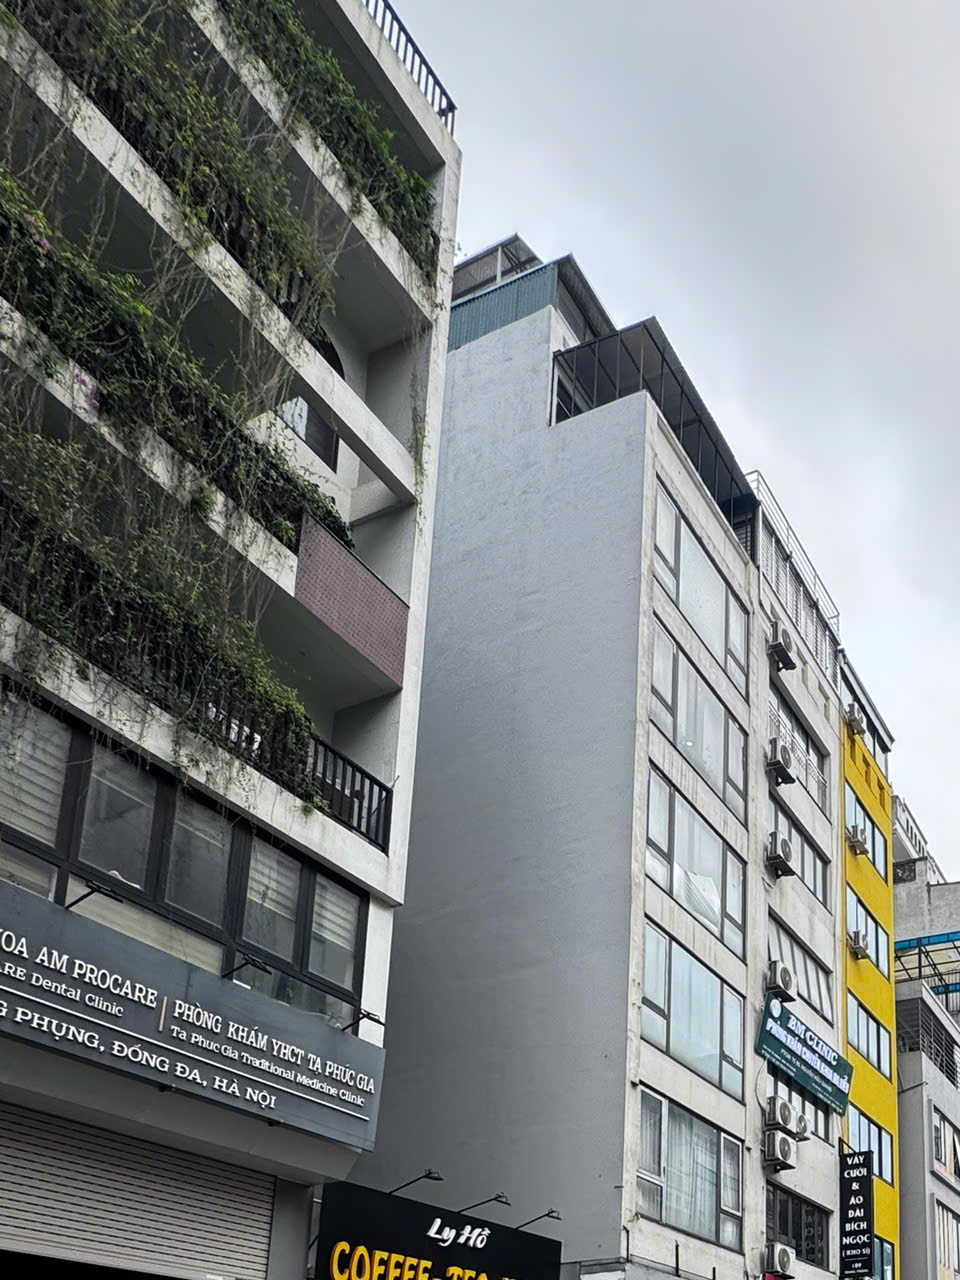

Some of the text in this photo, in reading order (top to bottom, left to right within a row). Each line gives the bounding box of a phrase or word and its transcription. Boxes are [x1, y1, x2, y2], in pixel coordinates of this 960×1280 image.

[0, 929, 158, 1008] OA AM PROCARE
[0, 962, 124, 1017] RE Dental Clinic
[14, 1007, 105, 1052] PHỤNG,
[112, 1043, 169, 1073] ĐỐNG
[175, 1062, 207, 1087] ĐA,
[213, 1075, 241, 1097] HÀ
[245, 1087, 277, 1110] NỘI
[170, 1025, 365, 1107] Ta Phuc Gia Traditional Medicine Clinic
[173, 1000, 375, 1094] PHÒNG KHÁM YHCT TẠ PHÚC GIA
[787, 1014, 806, 1039] BM
[805, 1030, 838, 1066] CLINIC
[851, 1181, 860, 1190] &
[426, 1218, 492, 1248] Ly Hồ
[842, 1234, 870, 1245] NGỌC
